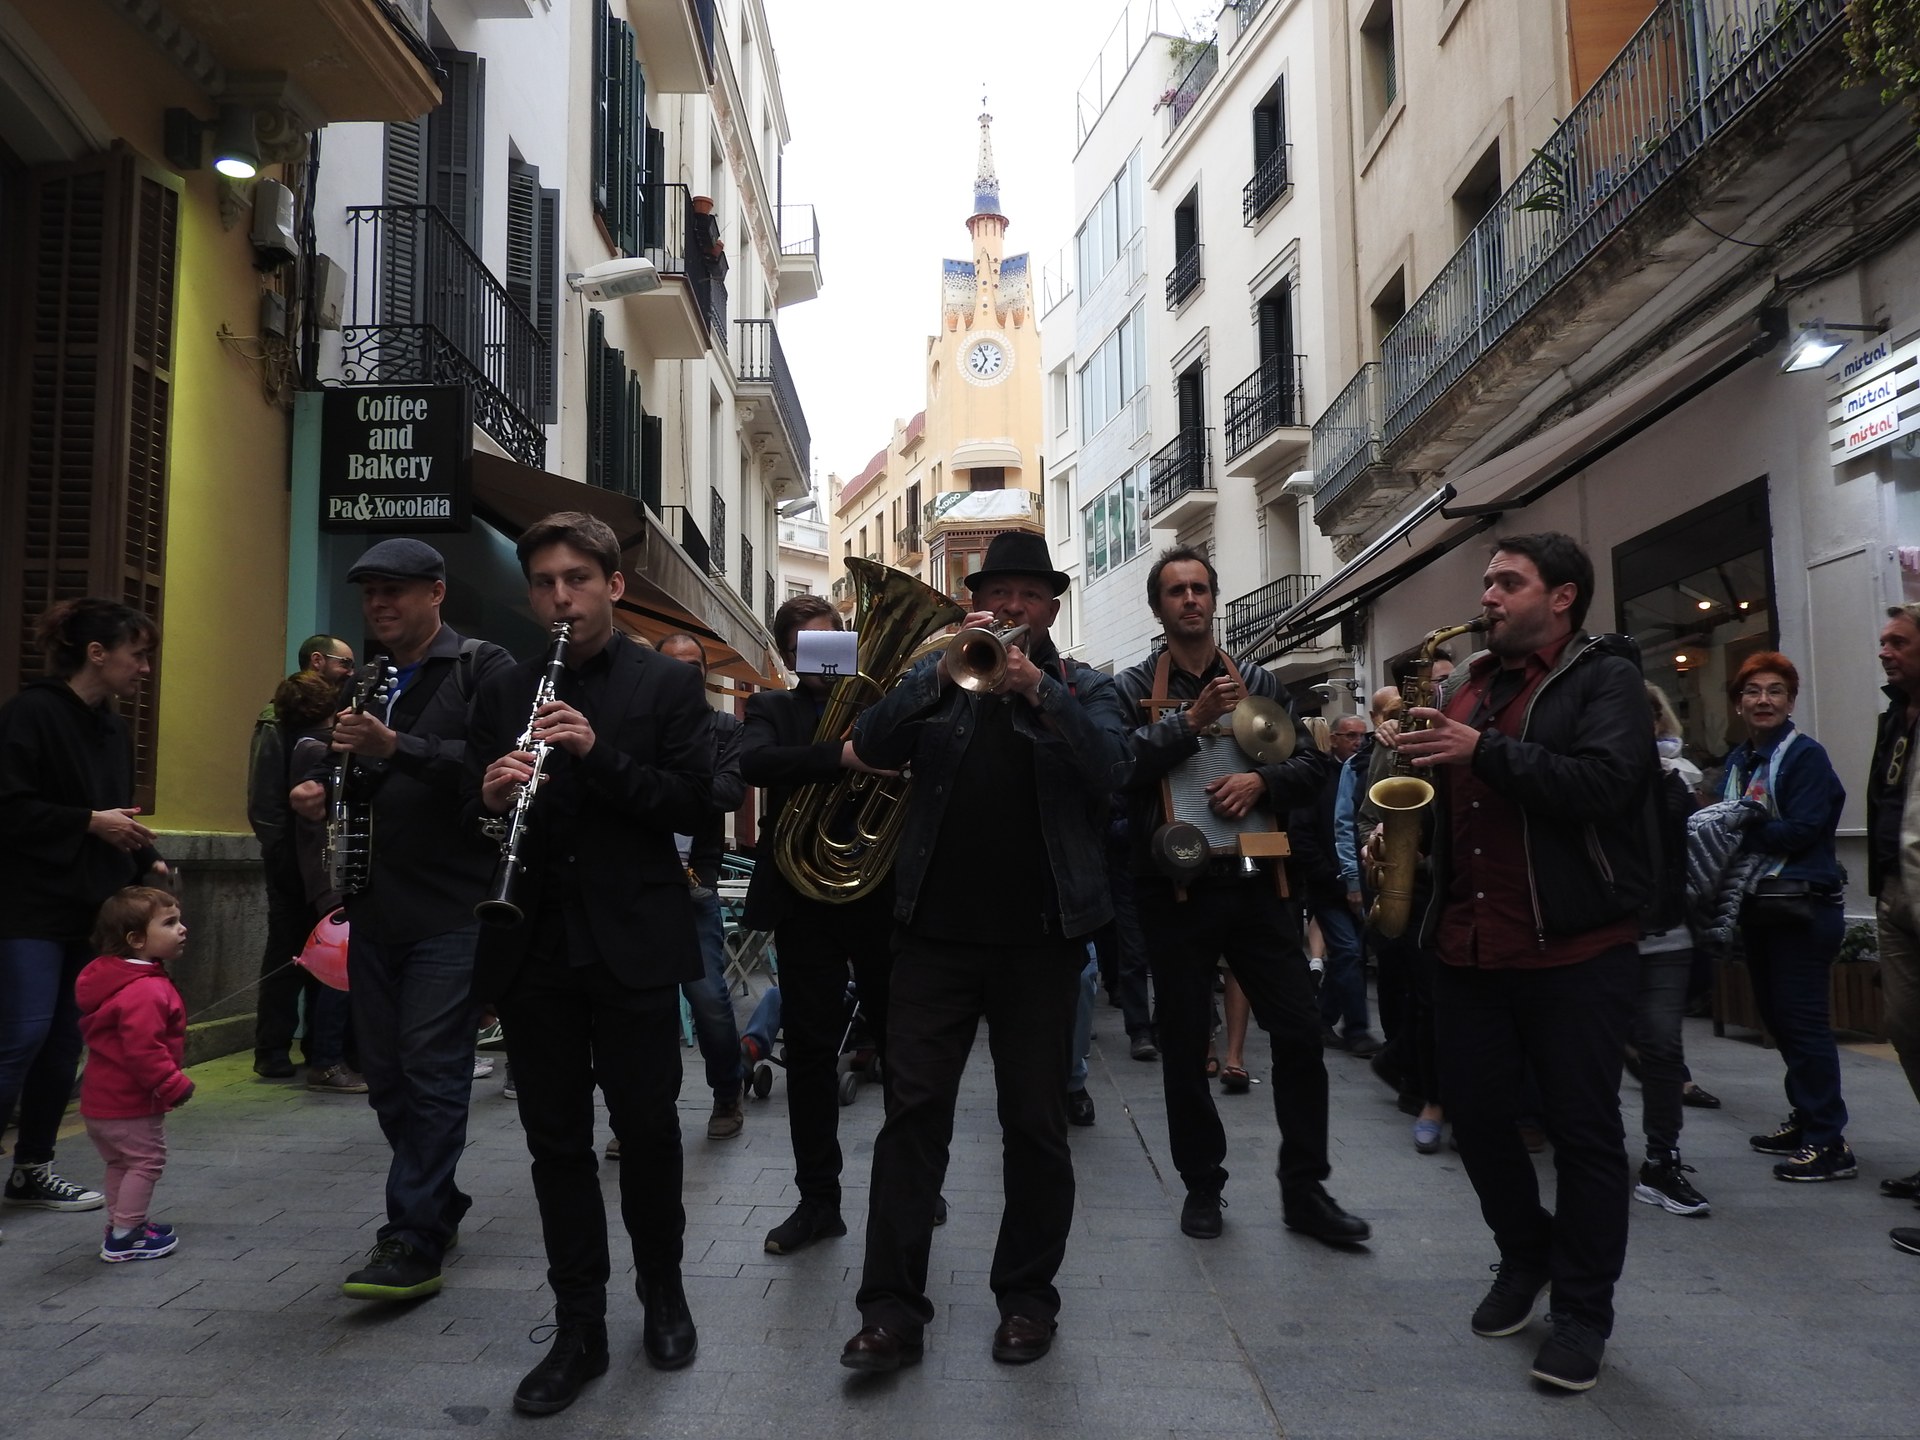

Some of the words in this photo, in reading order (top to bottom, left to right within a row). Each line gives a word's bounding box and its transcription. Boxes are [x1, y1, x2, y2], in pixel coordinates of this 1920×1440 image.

[1844, 342, 1887, 377] mistral
[357, 395, 428, 422] Coffee
[1847, 381, 1891, 414] mistral
[368, 424, 414, 450] and
[1849, 415, 1893, 447] mistral
[348, 453, 433, 482] Bakery
[328, 493, 451, 521] Pa&Xocolata
